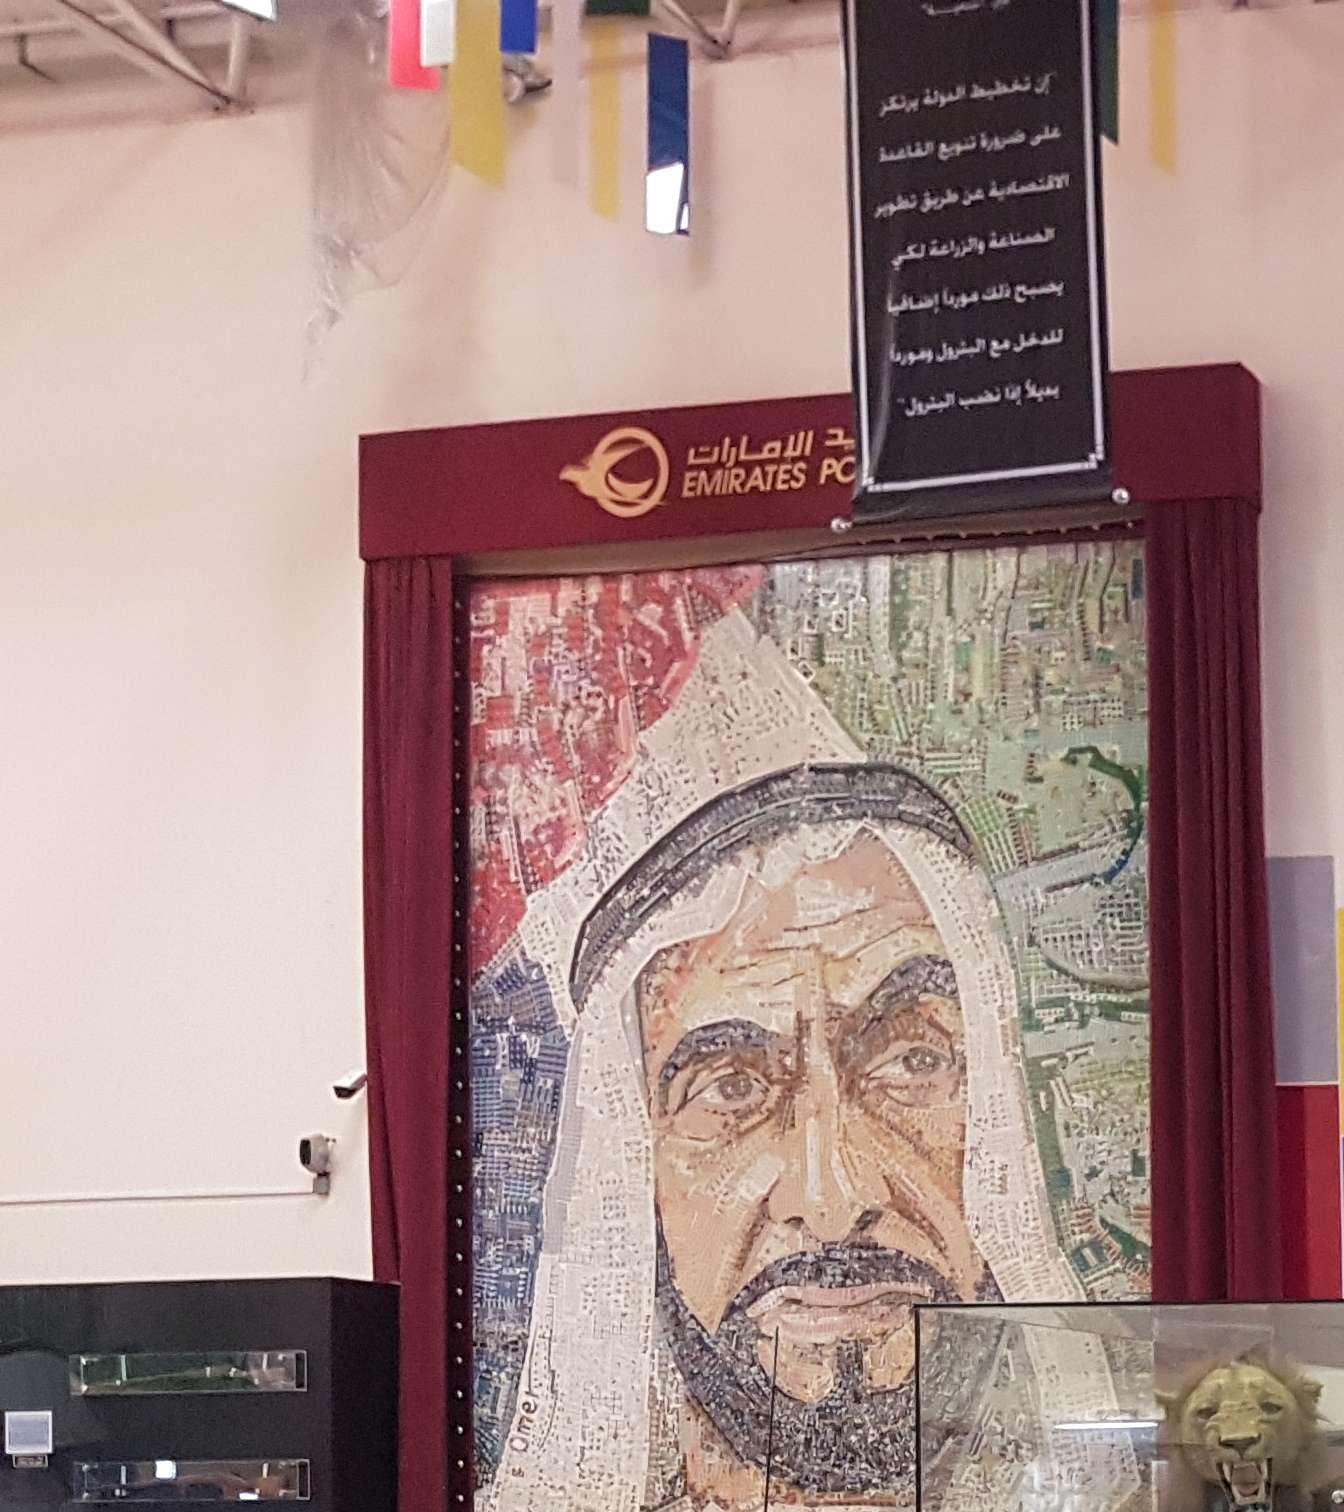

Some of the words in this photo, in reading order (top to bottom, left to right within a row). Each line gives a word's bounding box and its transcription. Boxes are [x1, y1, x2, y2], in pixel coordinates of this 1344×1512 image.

[1029, 125, 1062, 147] على
[873, 193, 918, 219] تطوير
[918, 187, 960, 213] طريق
[962, 187, 985, 207] عن
[928, 236, 986, 259] والزراعة
[988, 226, 1056, 250] الصناعة
[981, 282, 1011, 301] ذلك
[1013, 280, 1065, 304] يصبح
[934, 338, 987, 363] البترول
[989, 336, 1011, 359] مع
[1012, 328, 1064, 353] للدخل
[957, 386, 1002, 410] نضب
[681, 461, 808, 498] EMIRATES
[819, 455, 856, 485] PO
